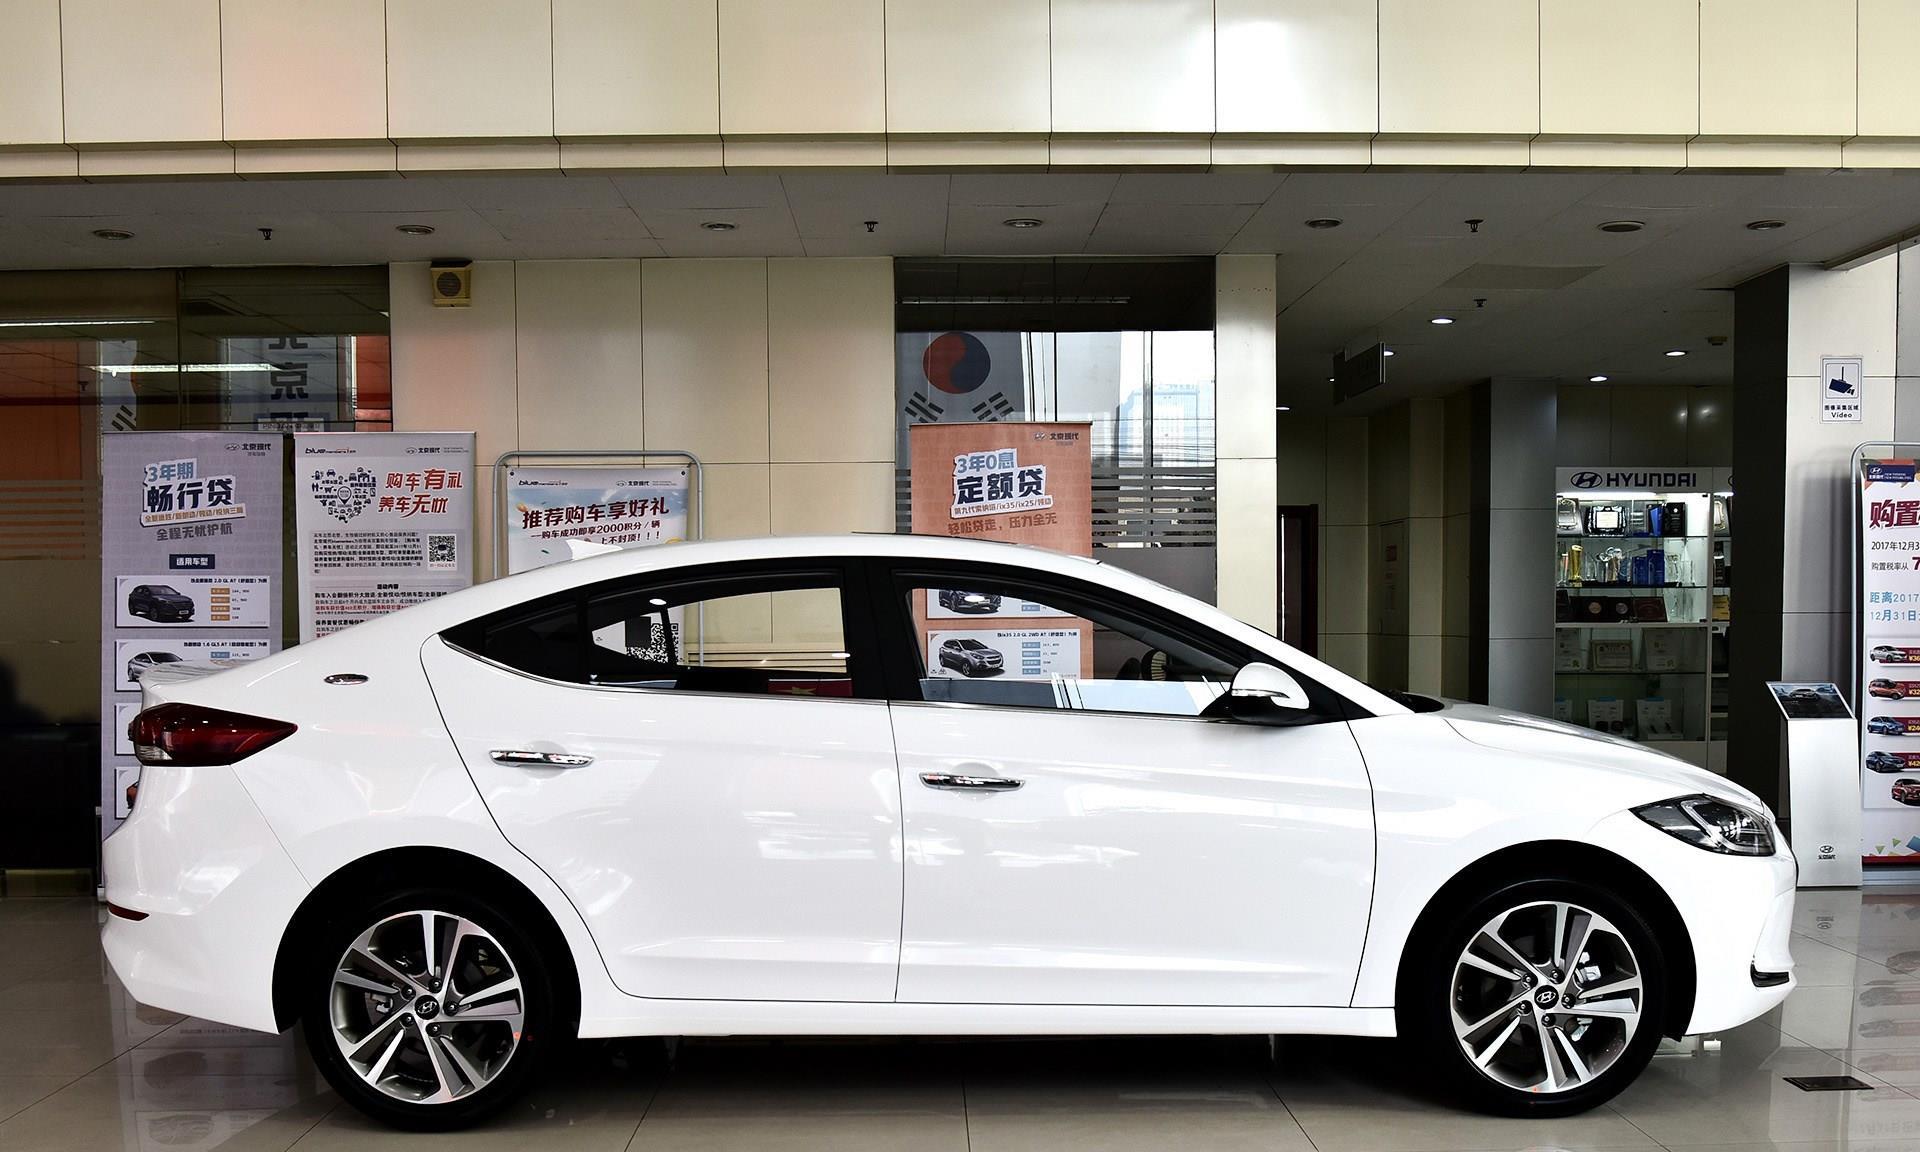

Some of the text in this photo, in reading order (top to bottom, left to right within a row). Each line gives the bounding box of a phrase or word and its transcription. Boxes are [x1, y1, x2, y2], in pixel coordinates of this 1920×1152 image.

[1050, 432, 1079, 440] 北京现代
[147, 462, 194, 482] 3年期
[957, 452, 1014, 473] 3年0息
[385, 469, 463, 492] 购车有礼
[957, 468, 1043, 505] 定额贷
[1606, 472, 1696, 487] HYUNDAI
[147, 478, 233, 513] 畅行贷
[378, 494, 449, 518] 养车无忧
[522, 496, 670, 529] 推荐购车享好礼
[1869, 499, 1920, 528] 购置
[156, 522, 233, 541] 全程无忧护航
[176, 558, 208, 566] 适用车型
[1869, 591, 1920, 604] 距离2017
[1870, 609, 1920, 621] 12月31日
